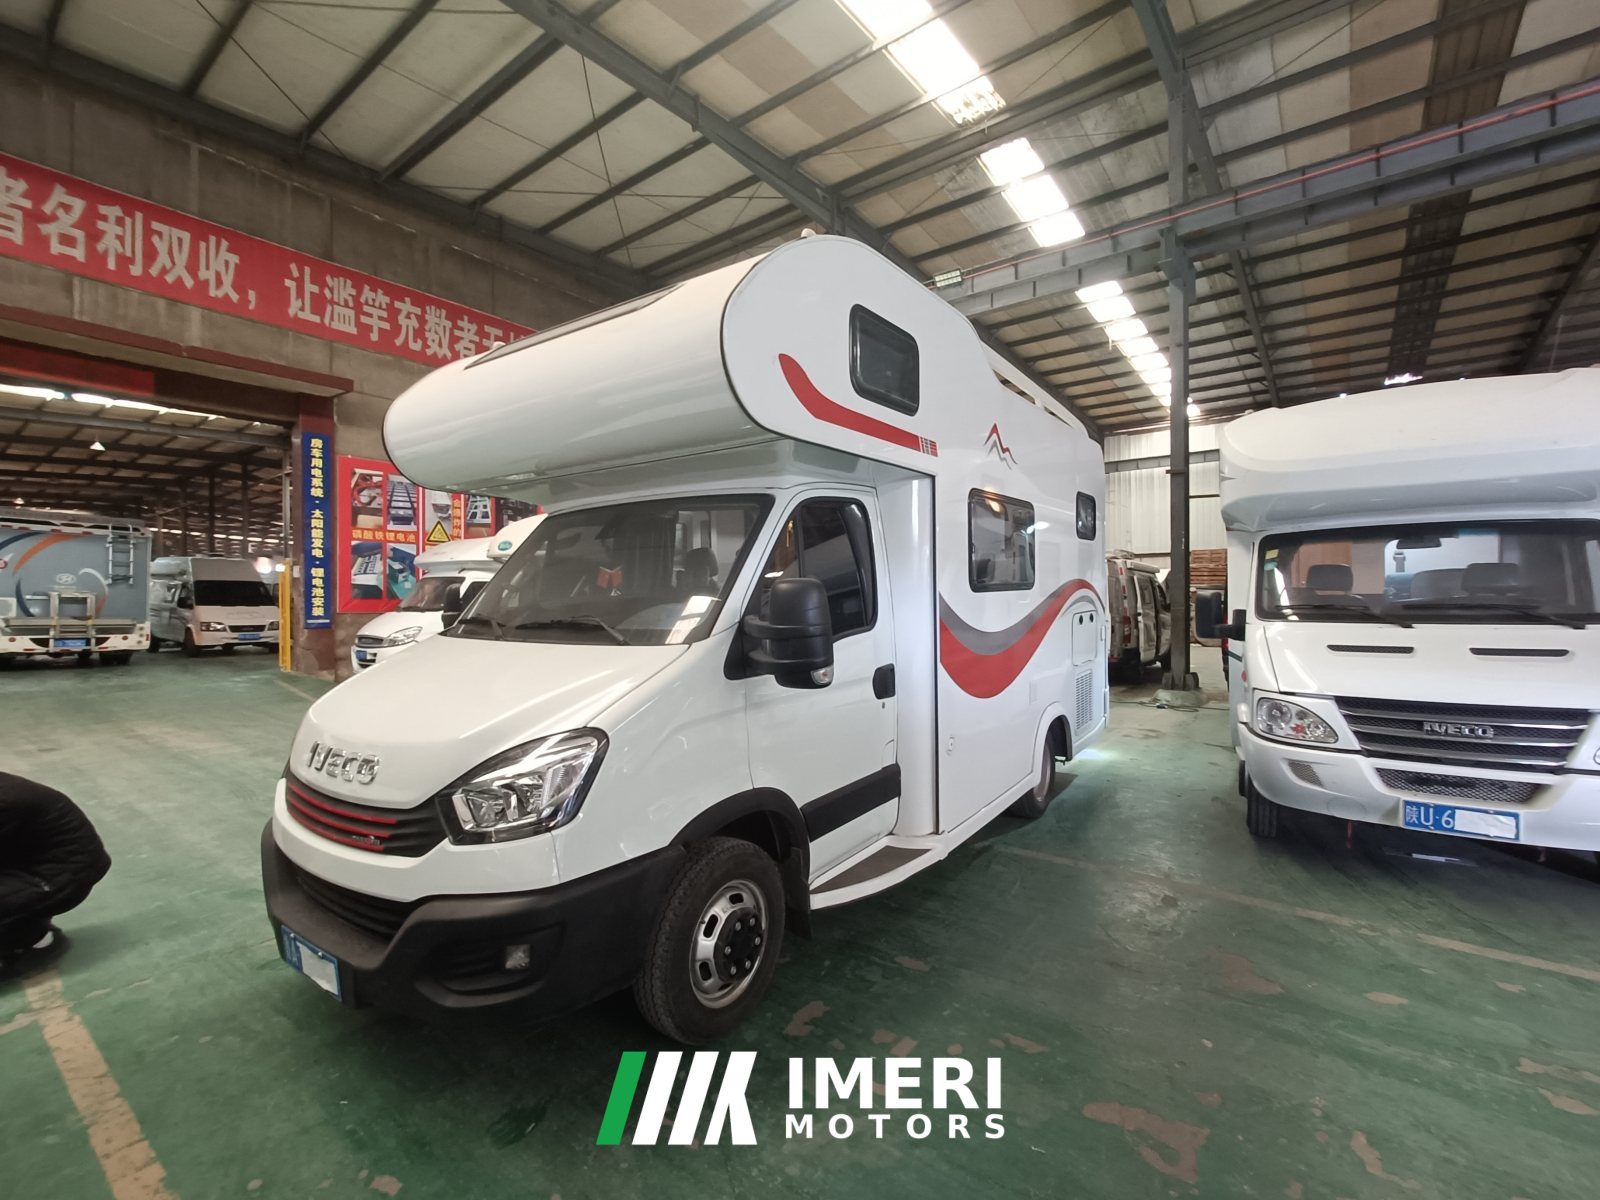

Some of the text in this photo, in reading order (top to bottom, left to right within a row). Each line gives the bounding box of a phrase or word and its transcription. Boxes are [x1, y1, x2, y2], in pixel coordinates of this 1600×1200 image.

[352, 529, 416, 542] 磷酸铁锂电池
[1423, 721, 1494, 738] IVECO
[307, 740, 380, 785] IVECO
